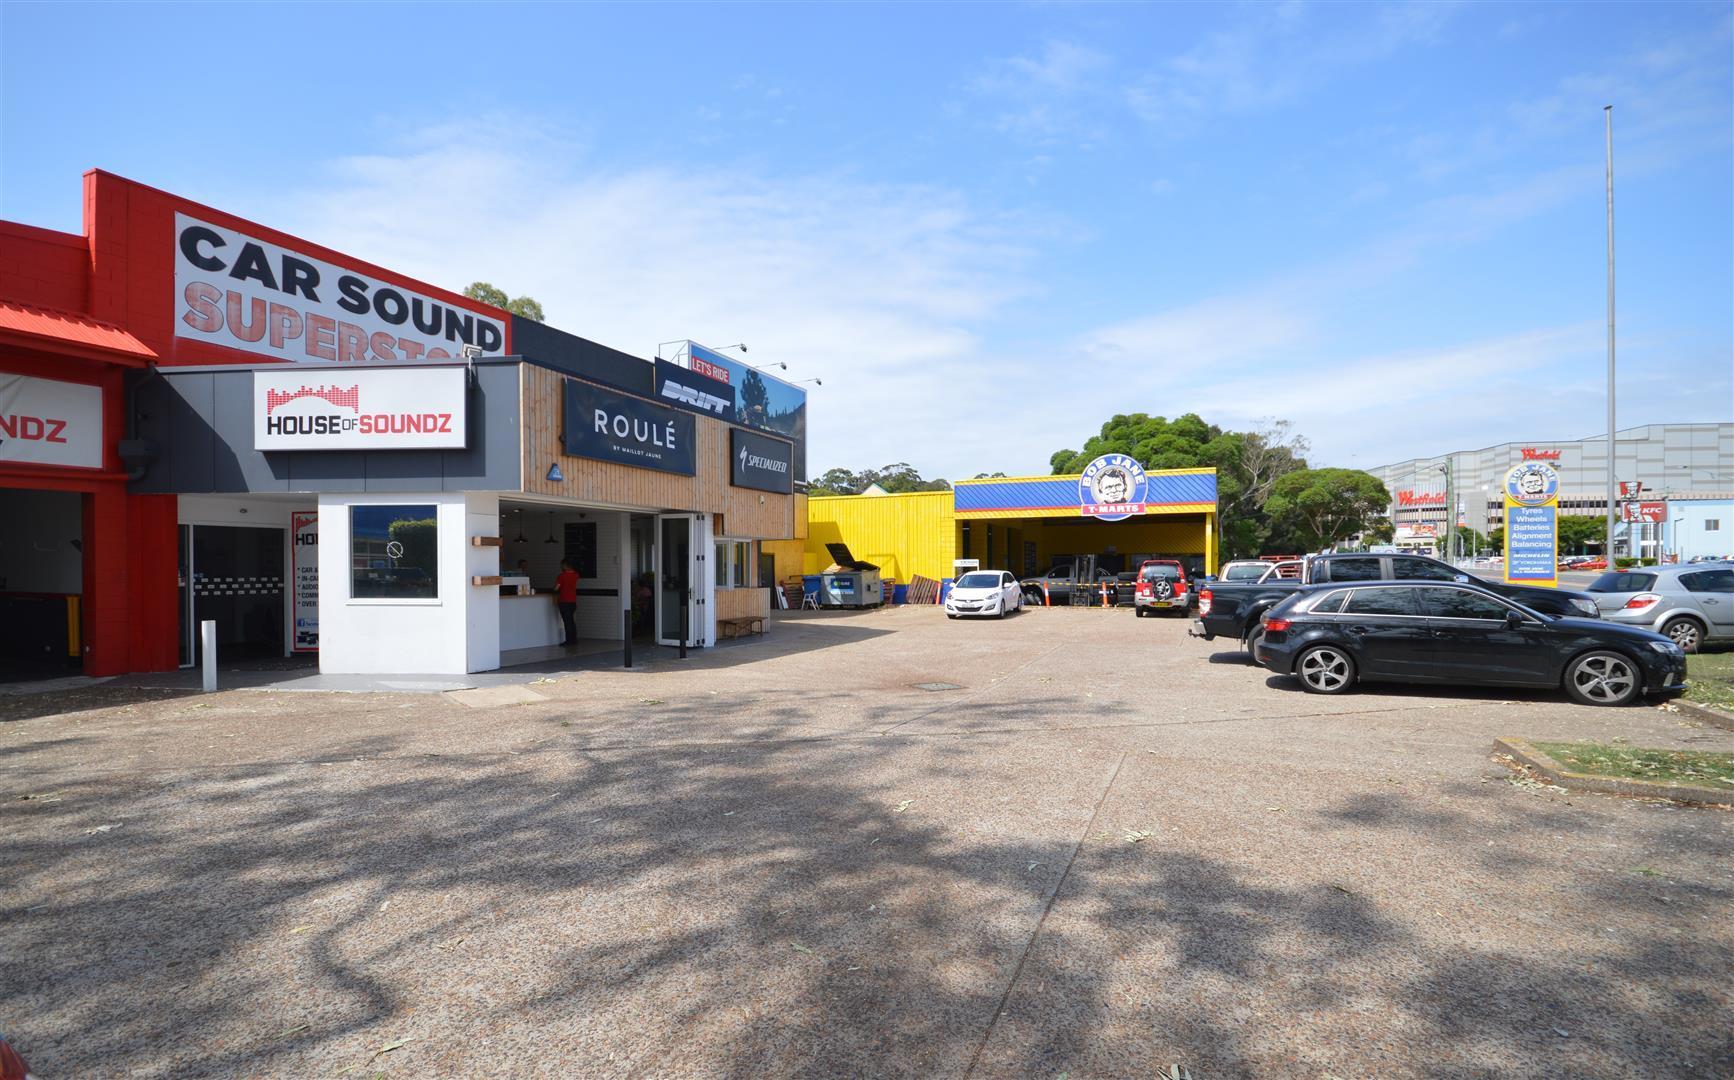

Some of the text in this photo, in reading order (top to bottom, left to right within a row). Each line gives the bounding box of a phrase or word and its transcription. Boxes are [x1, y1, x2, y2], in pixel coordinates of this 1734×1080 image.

[179, 225, 502, 352] CAR SOUND
[182, 281, 462, 362] SUPERST
[692, 357, 729, 382] LET'S RIDE
[661, 379, 731, 414] DRIFT
[267, 413, 452, 435] HOUSE OF SOUNDZ
[594, 408, 676, 449] ROULÉ
[621, 447, 644, 456] MAILLOT
[645, 452, 662, 460] JAUNE
[747, 454, 787, 473] SPECIALIZED
[1521, 447, 1561, 461] Westfield
[1082, 456, 1145, 487] BOB JANE
[1510, 465, 1529, 483] BOB
[1397, 489, 1447, 505] Westfield
[295, 533, 318, 546] HO
[1511, 532, 1553, 540] Alignment
